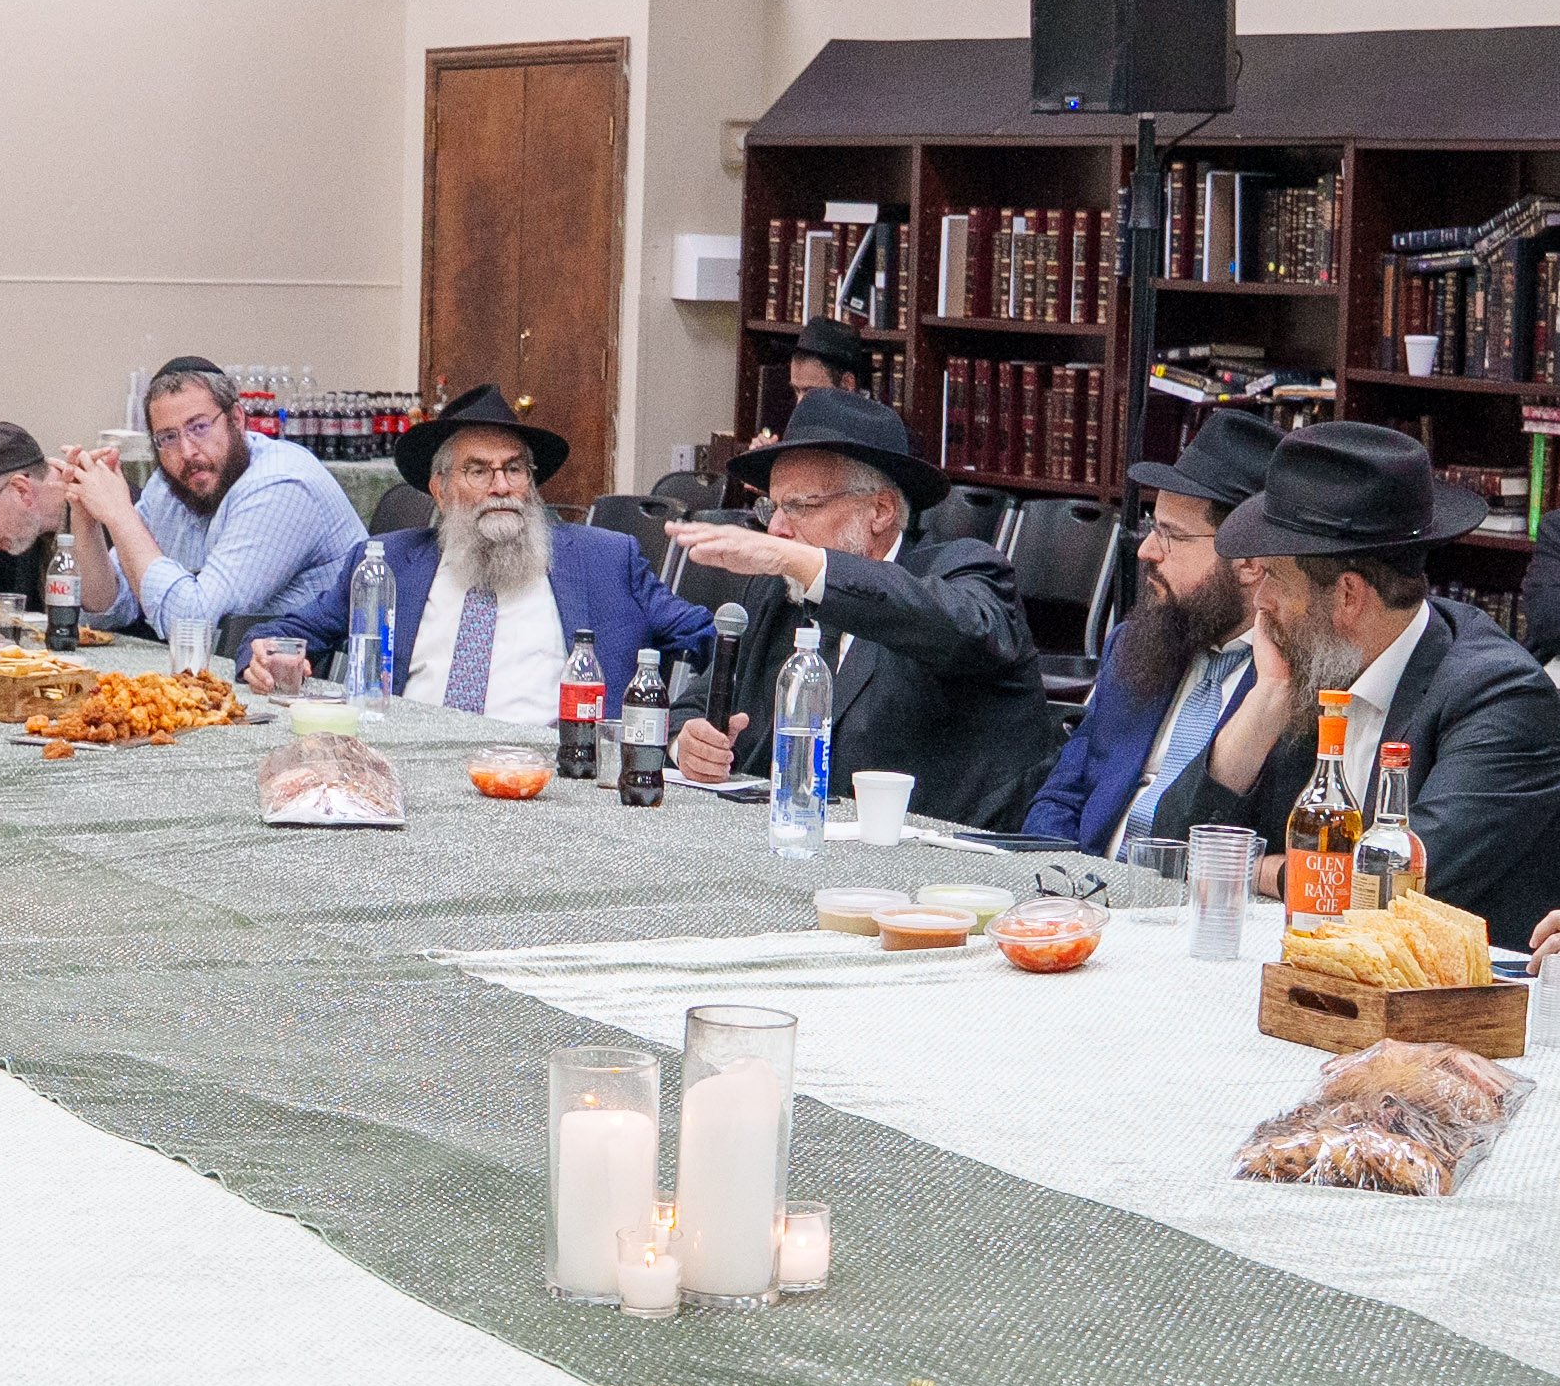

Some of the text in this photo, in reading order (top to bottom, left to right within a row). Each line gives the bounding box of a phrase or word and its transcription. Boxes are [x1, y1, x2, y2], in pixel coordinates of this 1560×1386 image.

[1330, 744, 1340, 755] 12
[1305, 855, 1346, 872] GLEN
[1319, 870, 1345, 886] MO
[1304, 883, 1336, 899] RAN
[1315, 898, 1339, 913] GIE
